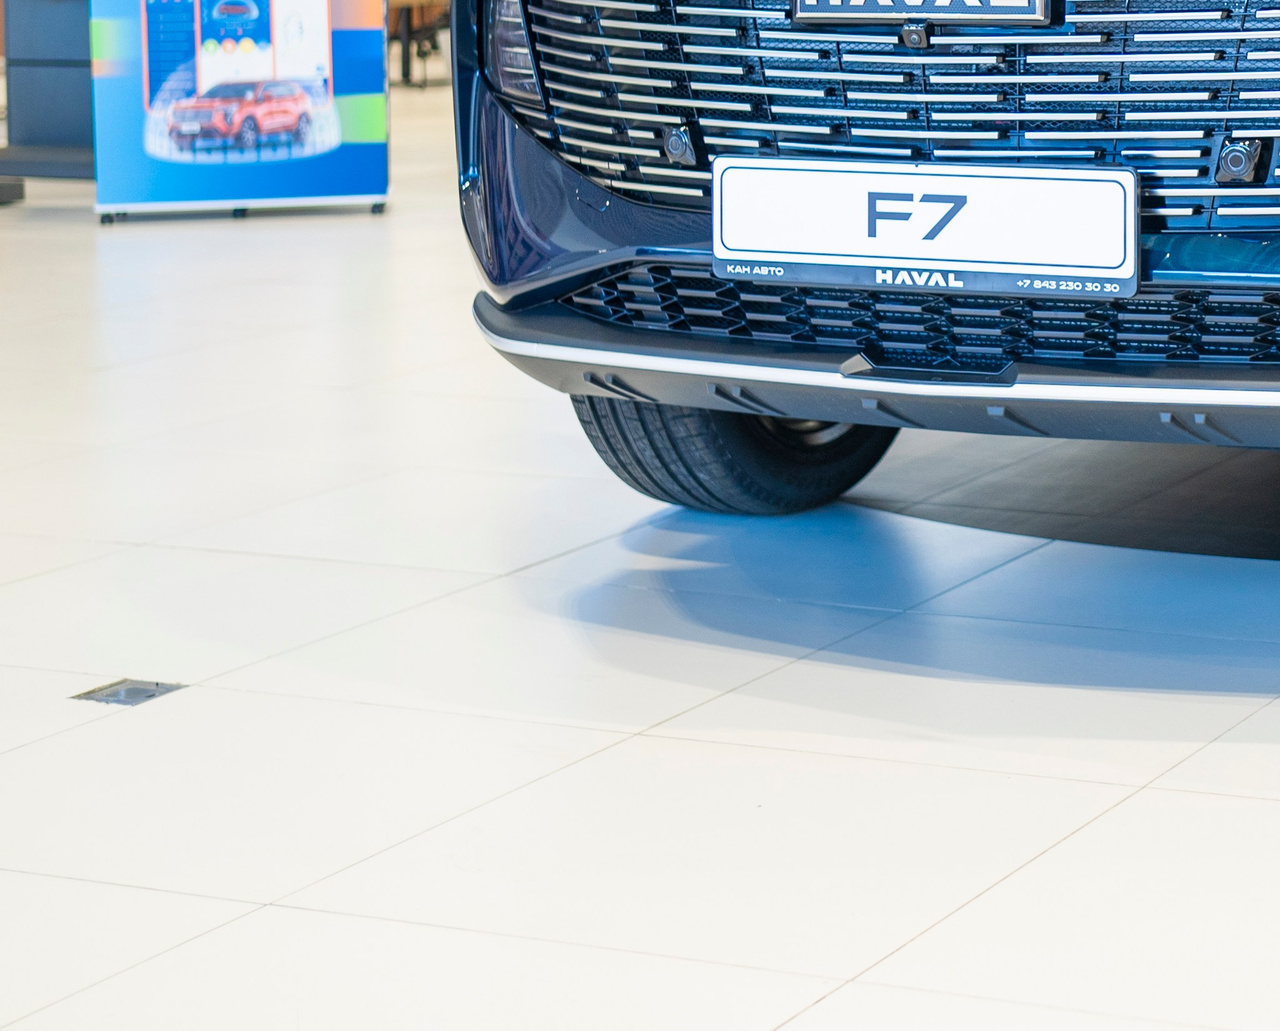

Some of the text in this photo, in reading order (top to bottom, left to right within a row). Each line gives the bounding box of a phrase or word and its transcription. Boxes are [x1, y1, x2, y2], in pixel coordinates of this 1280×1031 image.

[867, 191, 968, 241] F7
[726, 264, 785, 276] КАН АВТО
[875, 269, 964, 288] HAVAL
[1016, 279, 1120, 293] +7 843 230 30 30
